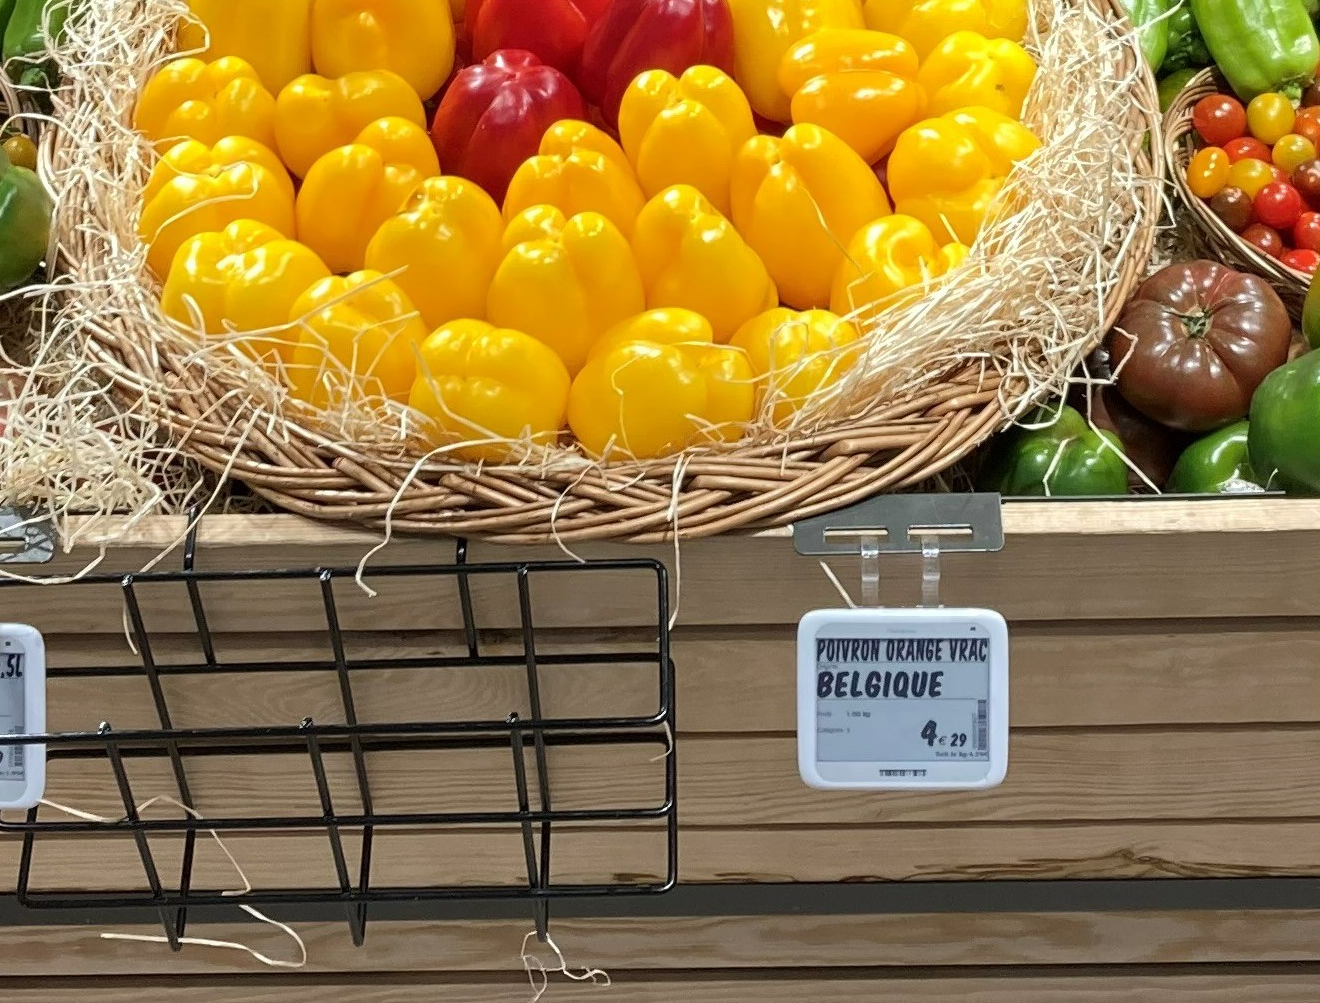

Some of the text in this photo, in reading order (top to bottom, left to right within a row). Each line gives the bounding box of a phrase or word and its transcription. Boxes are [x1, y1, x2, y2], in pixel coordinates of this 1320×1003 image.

[816, 638, 988, 662] POIVRON ORANGE VRAC
[816, 670, 944, 699] BELGIQUE
